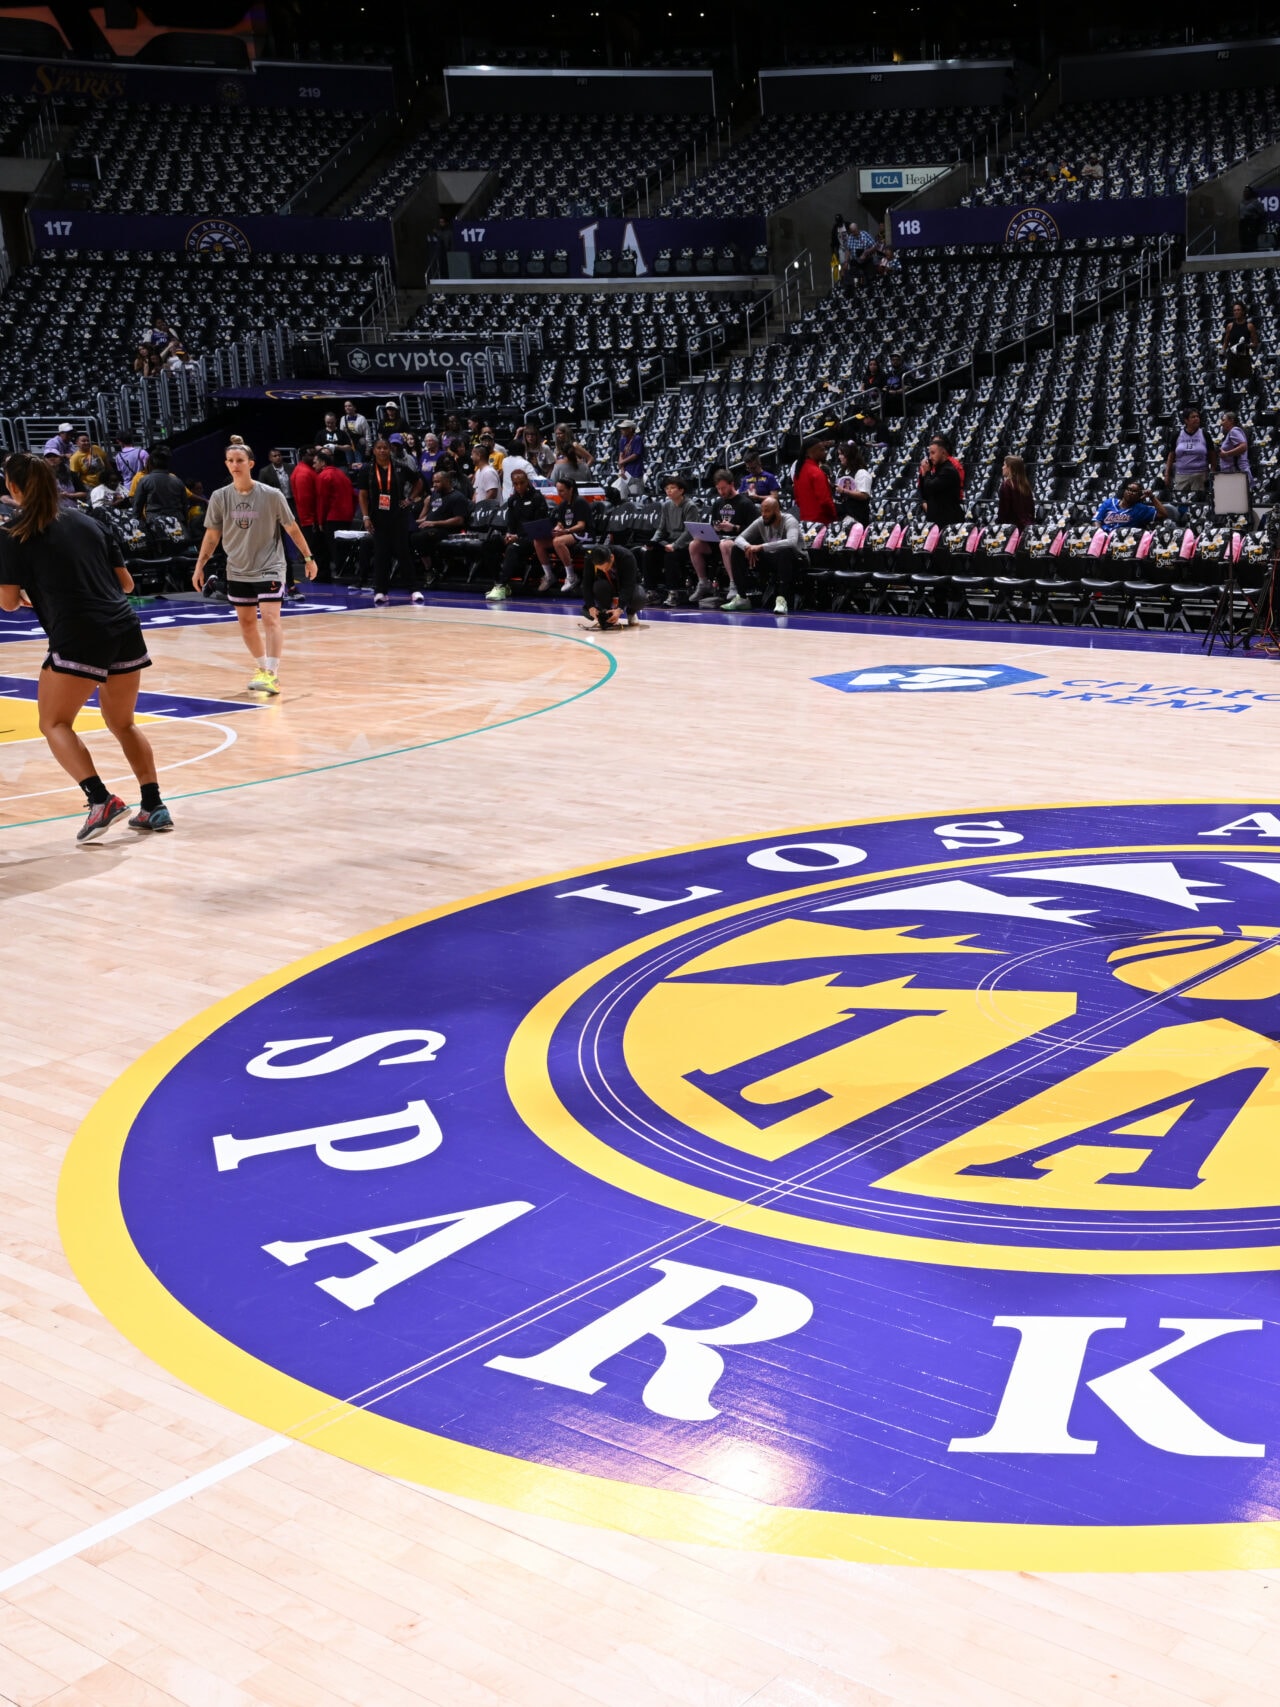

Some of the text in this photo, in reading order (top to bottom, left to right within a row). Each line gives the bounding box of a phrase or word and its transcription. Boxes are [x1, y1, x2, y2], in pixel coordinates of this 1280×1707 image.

[298, 87, 321, 98] 219
[875, 175, 899, 185] UCLA
[44, 221, 73, 236] 117
[461, 228, 486, 242] 117
[898, 220, 921, 235] 118
[1012, 690, 1252, 714] ARENA
[554, 820, 1024, 915] LOS
[680, 1008, 1270, 1194] LA
